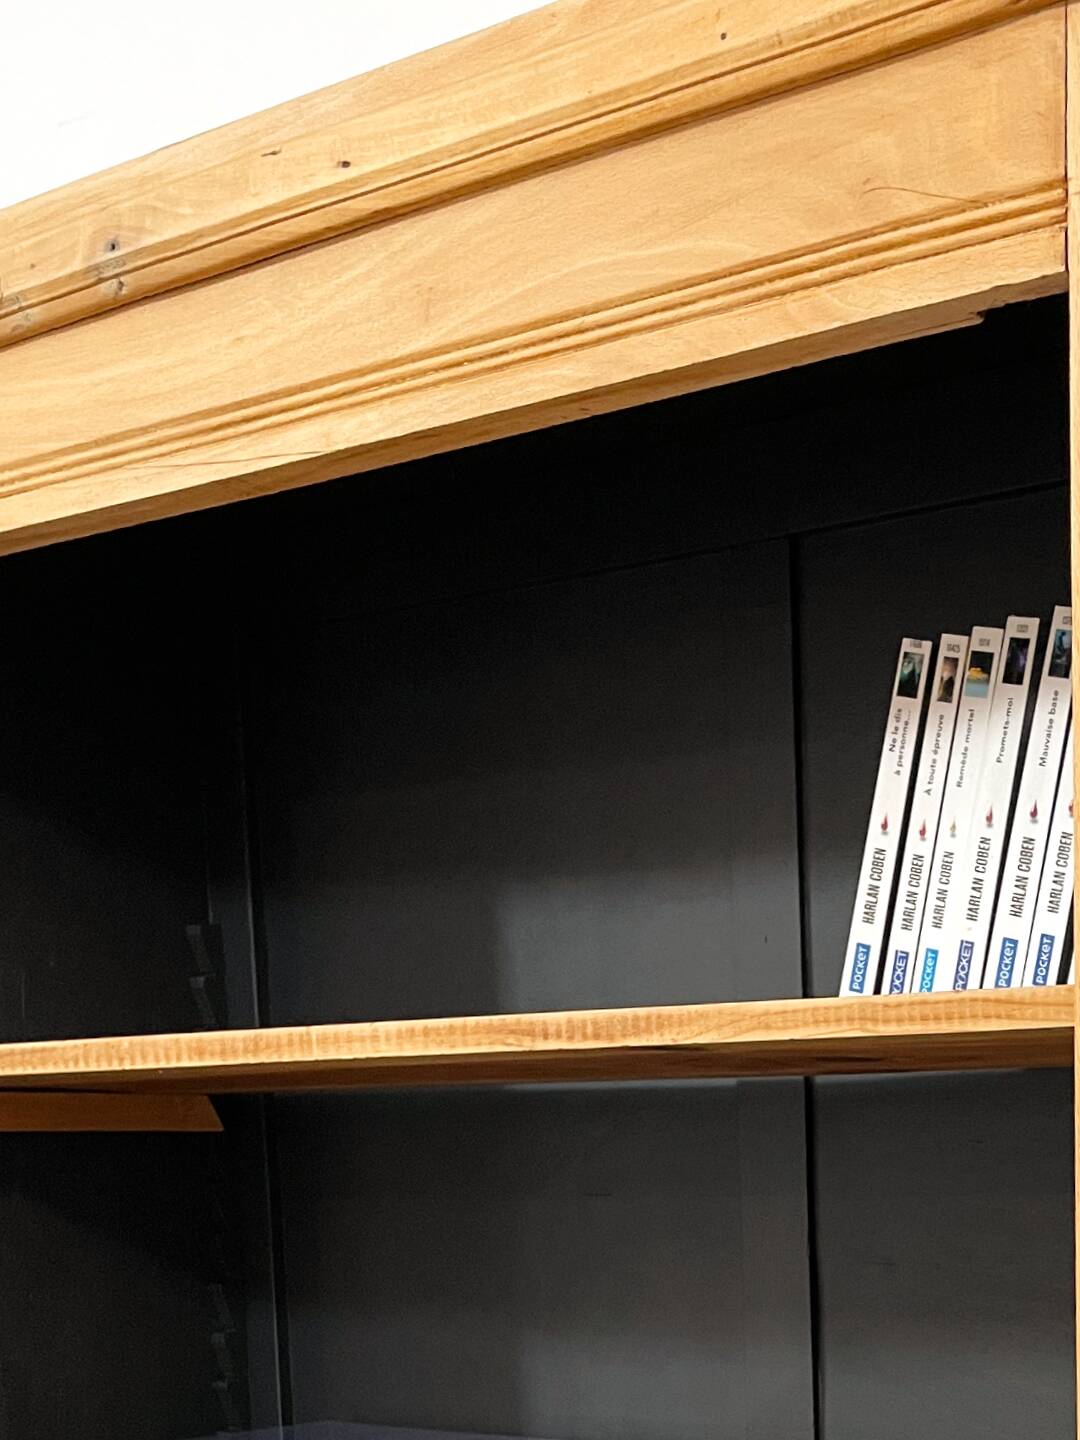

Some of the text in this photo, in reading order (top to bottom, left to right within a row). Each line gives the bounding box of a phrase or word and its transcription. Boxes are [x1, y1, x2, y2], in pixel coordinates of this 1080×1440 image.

[888, 737, 897, 753] Ne
[891, 726, 899, 735] le
[927, 758, 937, 785] toute
[932, 714, 945, 755] épreuve
[965, 708, 975, 743] mortel
[1038, 689, 1059, 767] Mauvaise base
[862, 847, 887, 925] HARLAN COBEN
[900, 853, 925, 931] HARLAN COBEN
[931, 850, 955, 929] HARLAN COBEN
[965, 836, 991, 922] HARLAN COBEN
[1008, 836, 1036, 918] HARLAN COBEN
[1046, 831, 1073, 914] HARLAN COBEN
